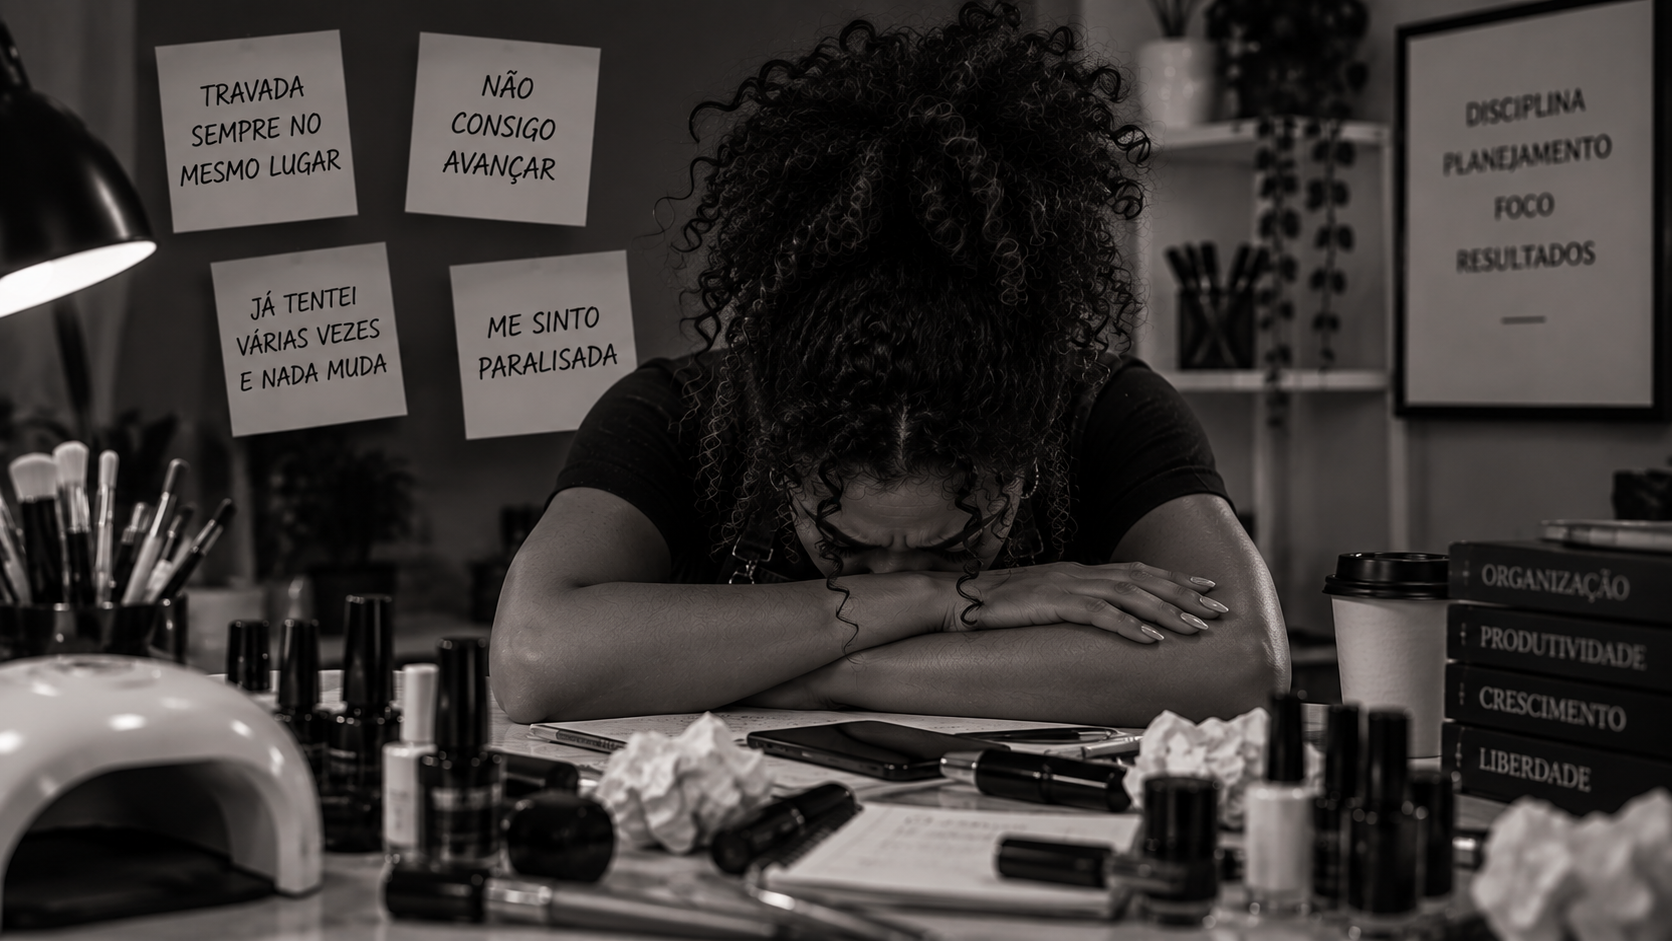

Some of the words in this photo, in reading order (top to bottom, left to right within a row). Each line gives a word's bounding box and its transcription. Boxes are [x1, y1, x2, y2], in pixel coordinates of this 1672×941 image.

[200, 75, 305, 107] TRAVADA
[481, 70, 534, 100] NÃO
[1465, 87, 1586, 128] DISCIPLINA
[191, 116, 281, 147] SEMPRE
[290, 112, 322, 137] NO
[451, 111, 556, 142] CONSIGO
[181, 158, 261, 187] MESMO
[269, 148, 342, 177] LUGAR
[442, 149, 556, 185] AVANÇAR
[1443, 133, 1613, 177] PLANEJAMENTO
[1494, 191, 1555, 222] FOCO
[1455, 239, 1596, 275] RESULTADOS
[250, 290, 275, 321] JÁ
[283, 286, 357, 315] TENTEI
[487, 313, 522, 339] ME
[531, 305, 600, 334] SINTO
[236, 326, 309, 356] VÁRIAS
[316, 318, 381, 346] VEZES
[239, 370, 253, 391] E
[261, 362, 319, 390] NADA
[326, 353, 387, 382] MUDA
[478, 343, 618, 380] PARALISADA
[1481, 563, 1631, 603] ORGANIZAÇÃO
[1480, 625, 1648, 671] PRODUTIVIDADE
[1479, 685, 1627, 733] CRESCIMENTO
[1479, 747, 1592, 793] LIBERDADE
